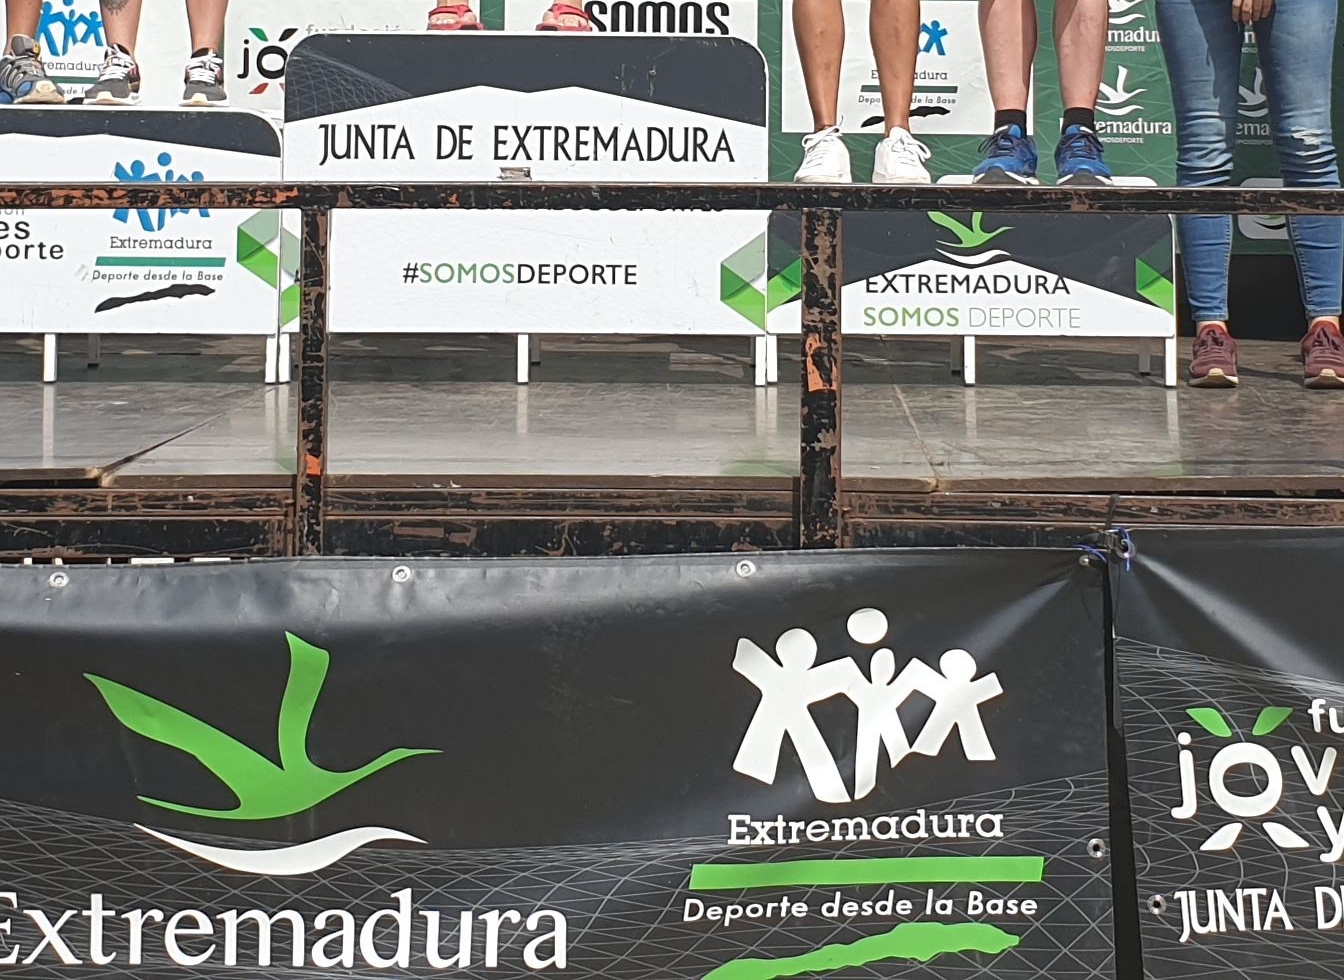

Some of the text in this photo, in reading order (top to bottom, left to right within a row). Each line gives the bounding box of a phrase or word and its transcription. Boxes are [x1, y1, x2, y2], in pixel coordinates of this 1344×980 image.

[318, 123, 736, 166] JUNTA DE EXTREMADURA
[110, 235, 213, 250] Extremadura
[92, 269, 224, 283] Deporte desde la Base
[402, 261, 638, 286] #SOMOSDEPORTE
[864, 273, 1071, 295] EXTREMADURA
[863, 306, 1082, 329] SOMOS DEPORTE
[727, 809, 1004, 847] Extremadura
[683, 889, 1038, 927] Deporte desde la Base
[1173, 886, 1295, 943] JUNTA
